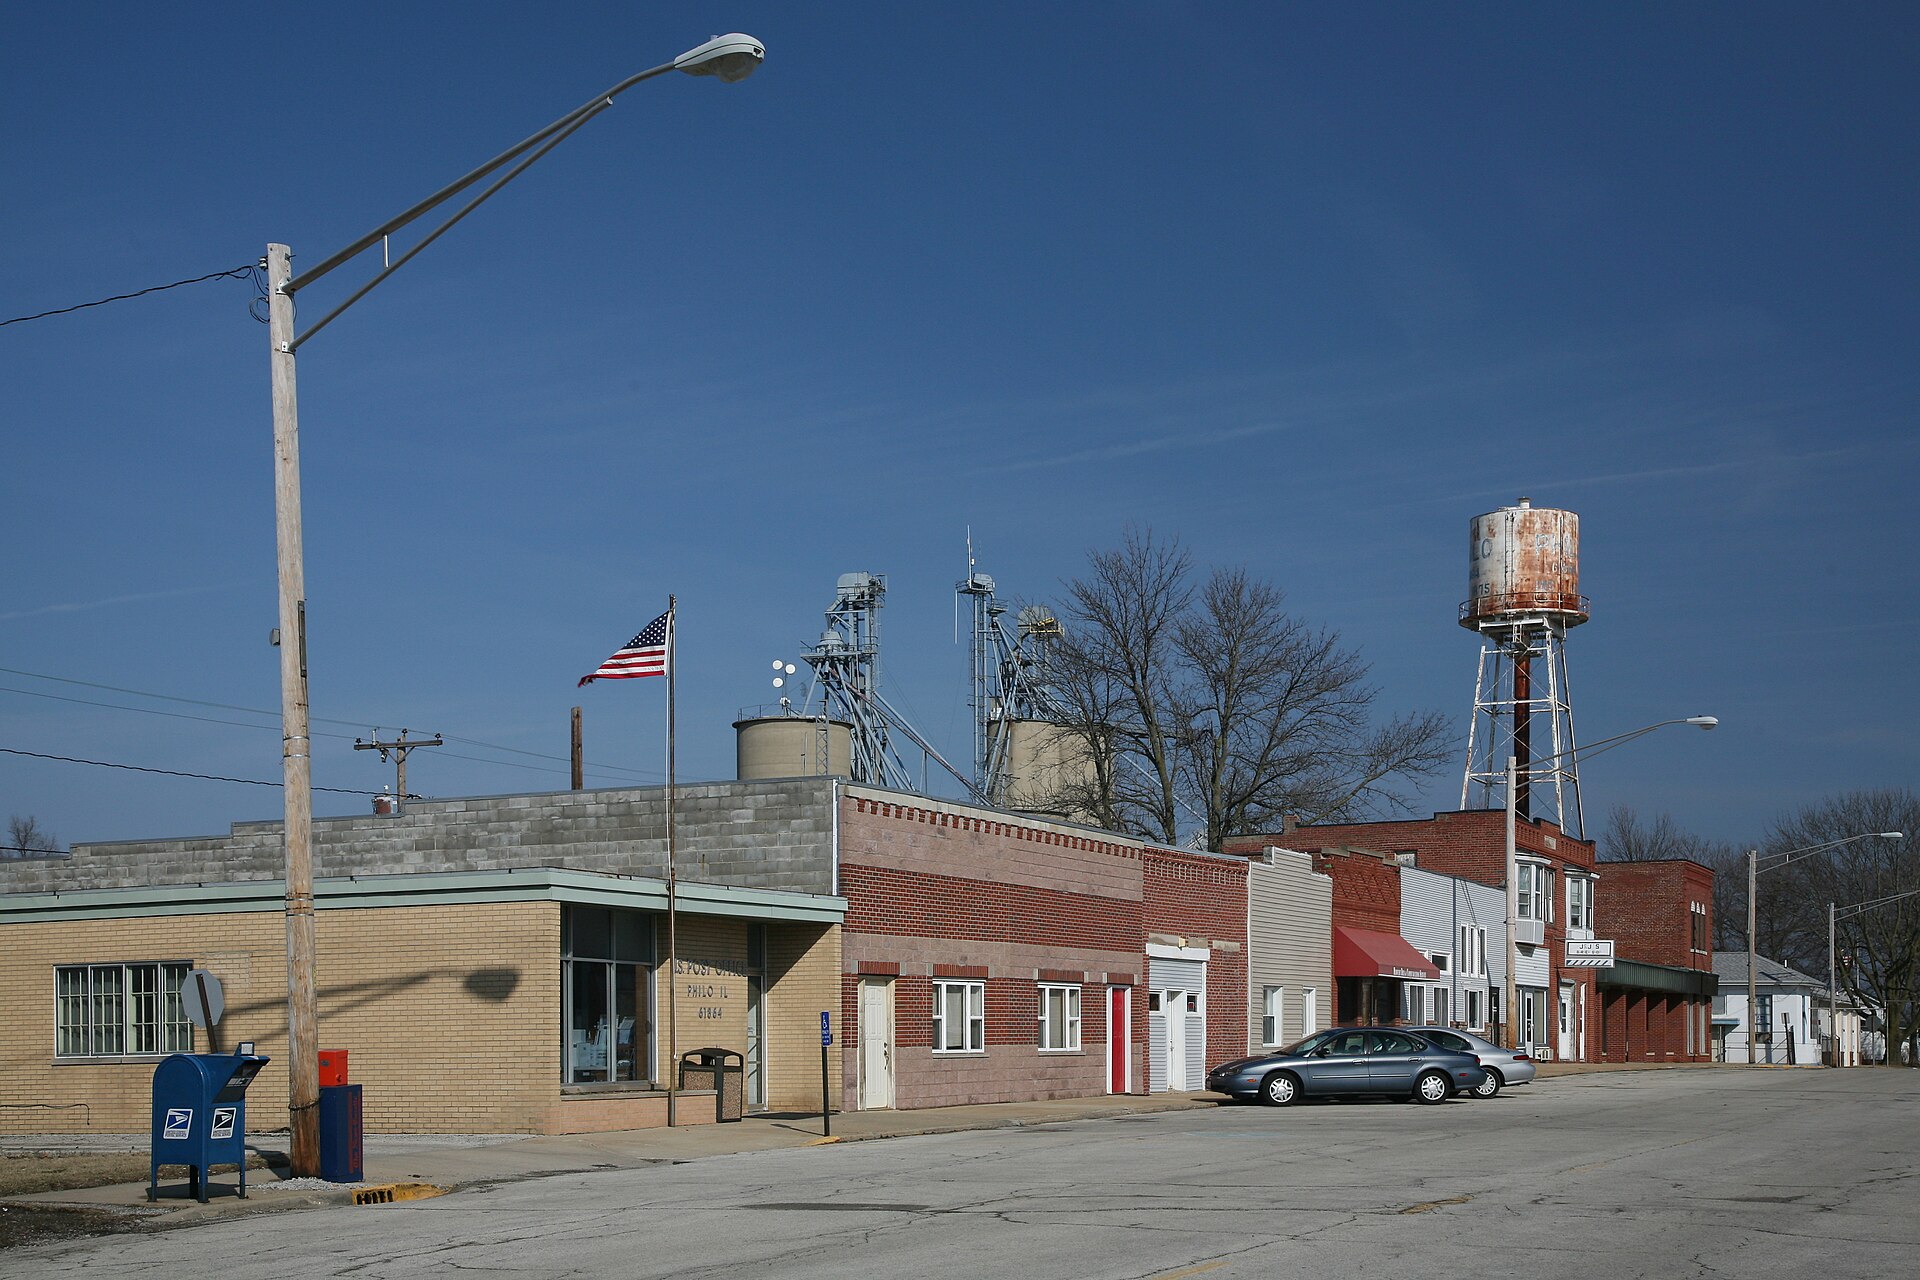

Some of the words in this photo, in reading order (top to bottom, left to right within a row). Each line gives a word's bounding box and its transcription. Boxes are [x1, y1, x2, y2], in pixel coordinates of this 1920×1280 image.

[687, 959, 711, 976] POST
[715, 960, 748, 978] OFFICE
[687, 984, 713, 998] PHILO
[720, 985, 728, 999] IL
[698, 1007, 722, 1019] 61864
